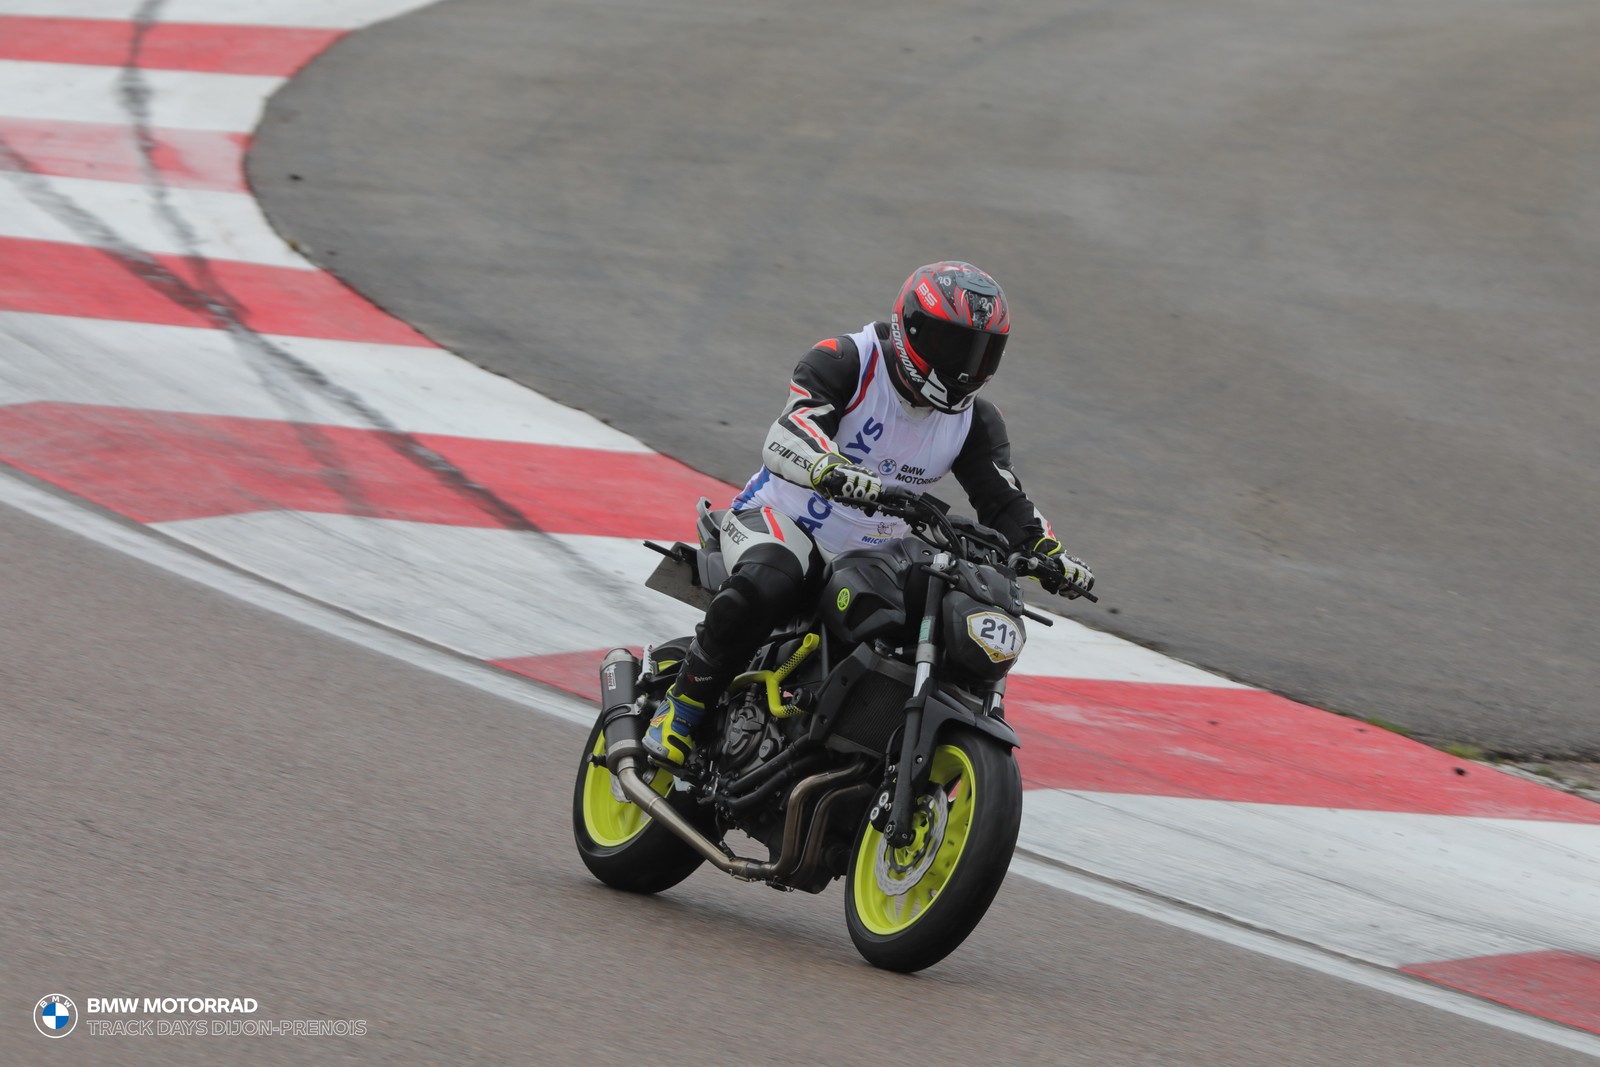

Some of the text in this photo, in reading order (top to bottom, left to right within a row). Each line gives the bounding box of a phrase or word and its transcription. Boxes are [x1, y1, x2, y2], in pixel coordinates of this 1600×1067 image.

[917, 282, 938, 307] BS
[891, 313, 923, 380] SCORPION
[900, 464, 926, 476] BMW
[980, 618, 1017, 651] 211
